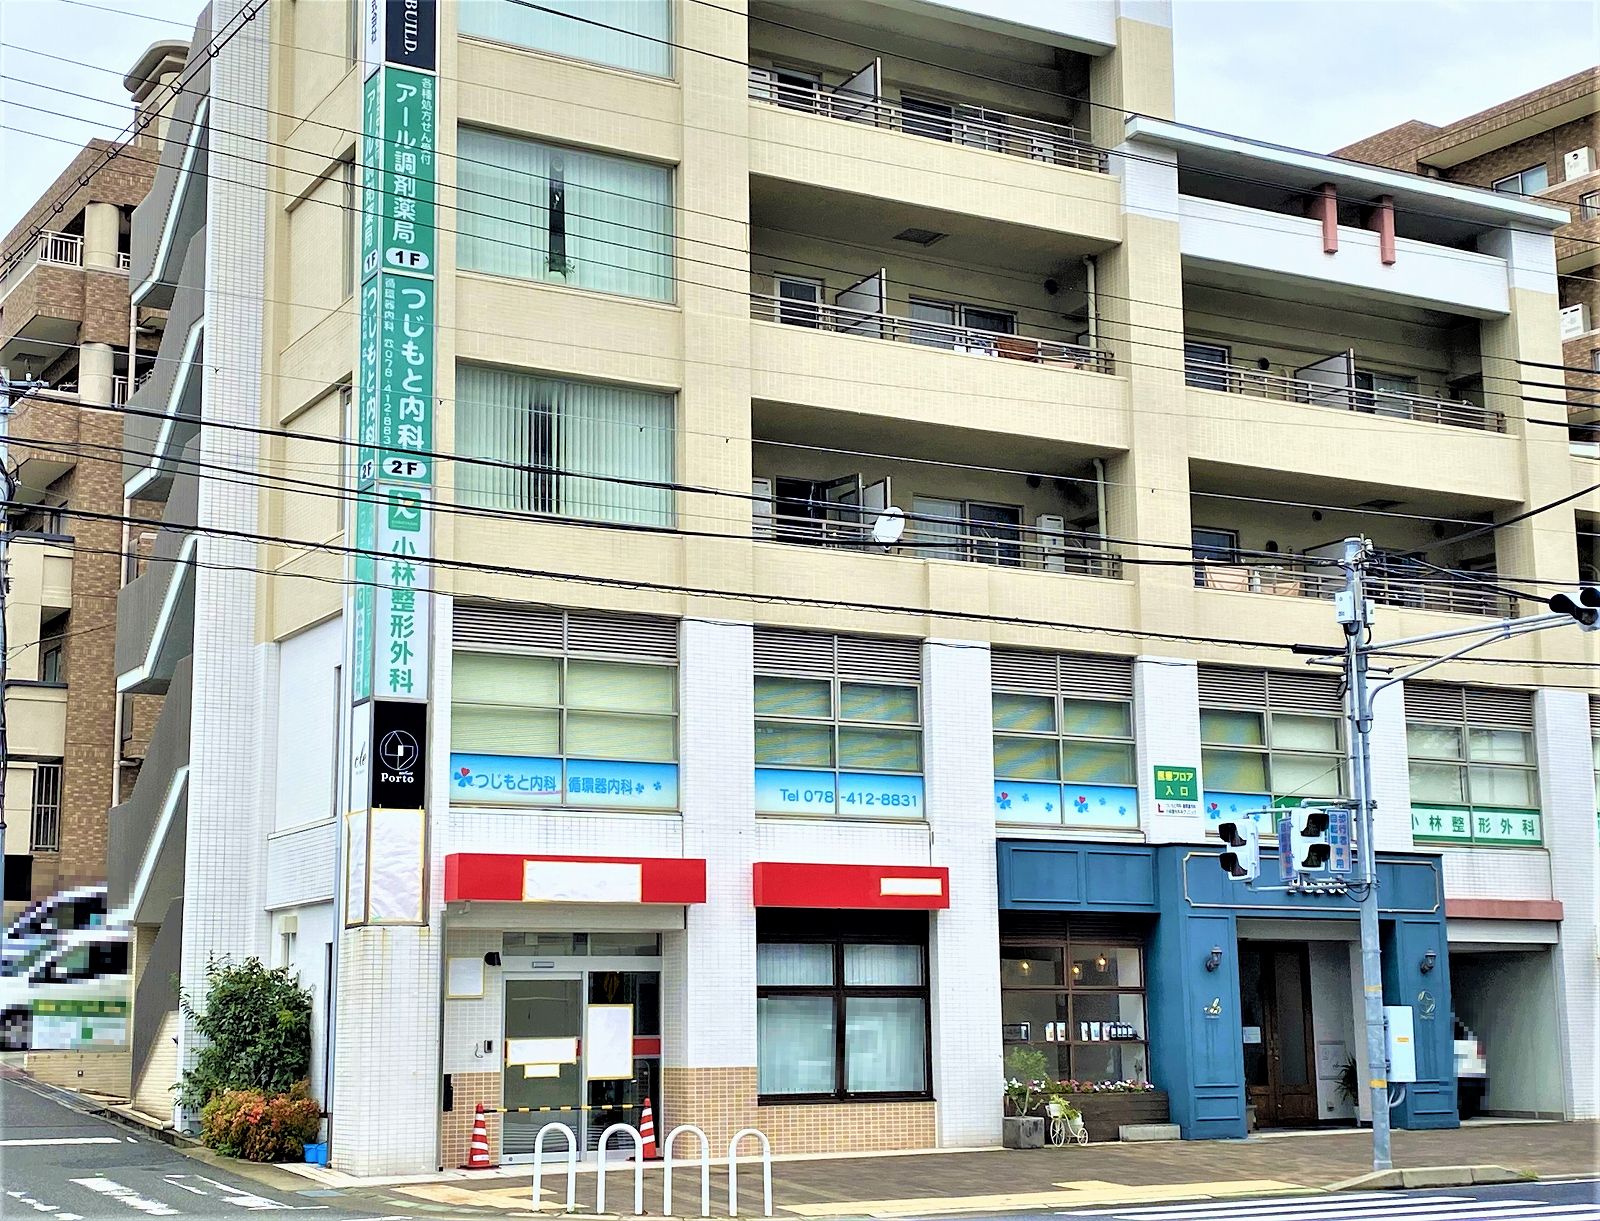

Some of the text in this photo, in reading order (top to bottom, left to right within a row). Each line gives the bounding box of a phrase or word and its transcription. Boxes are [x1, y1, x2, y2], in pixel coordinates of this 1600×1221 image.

[393, 83, 418, 244] アール調剤薬局
[395, 250, 421, 266] 1F
[398, 287, 426, 451] つじもと内科
[391, 460, 418, 475] 2F
[389, 536, 416, 693] 小林整形外科
[381, 772, 414, 783] Porto
[475, 773, 633, 795] つじもと内科 循環器内科
[780, 788, 800, 802] Tel
[1165, 785, 1189, 797] 入口
